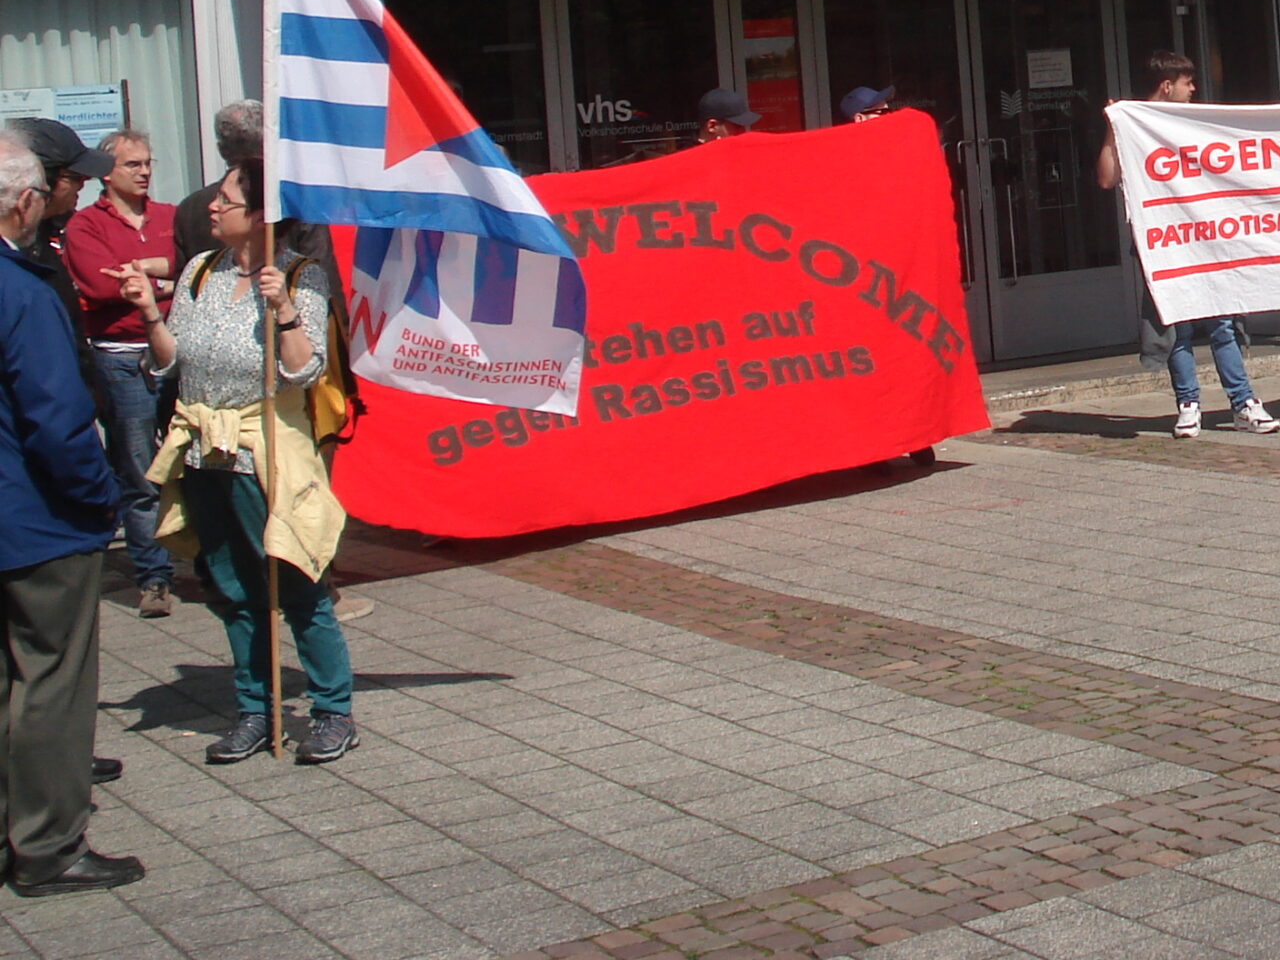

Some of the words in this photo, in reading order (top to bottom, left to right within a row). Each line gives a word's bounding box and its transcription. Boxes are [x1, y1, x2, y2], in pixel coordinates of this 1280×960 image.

[577, 94, 633, 124] vhs
[577, 123, 663, 139] Volkshochschule
[665, 119, 700, 133] Darms
[552, 201, 965, 375] WELCOME
[741, 300, 816, 341] auf
[395, 344, 563, 373] ANTIFASCHISTINNEN
[401, 327, 446, 351] BUND
[451, 343, 480, 358] DER
[392, 358, 427, 373] UND
[431, 364, 567, 391] ANTIFASCHISTEN
[591, 344, 875, 422] Rassismus
